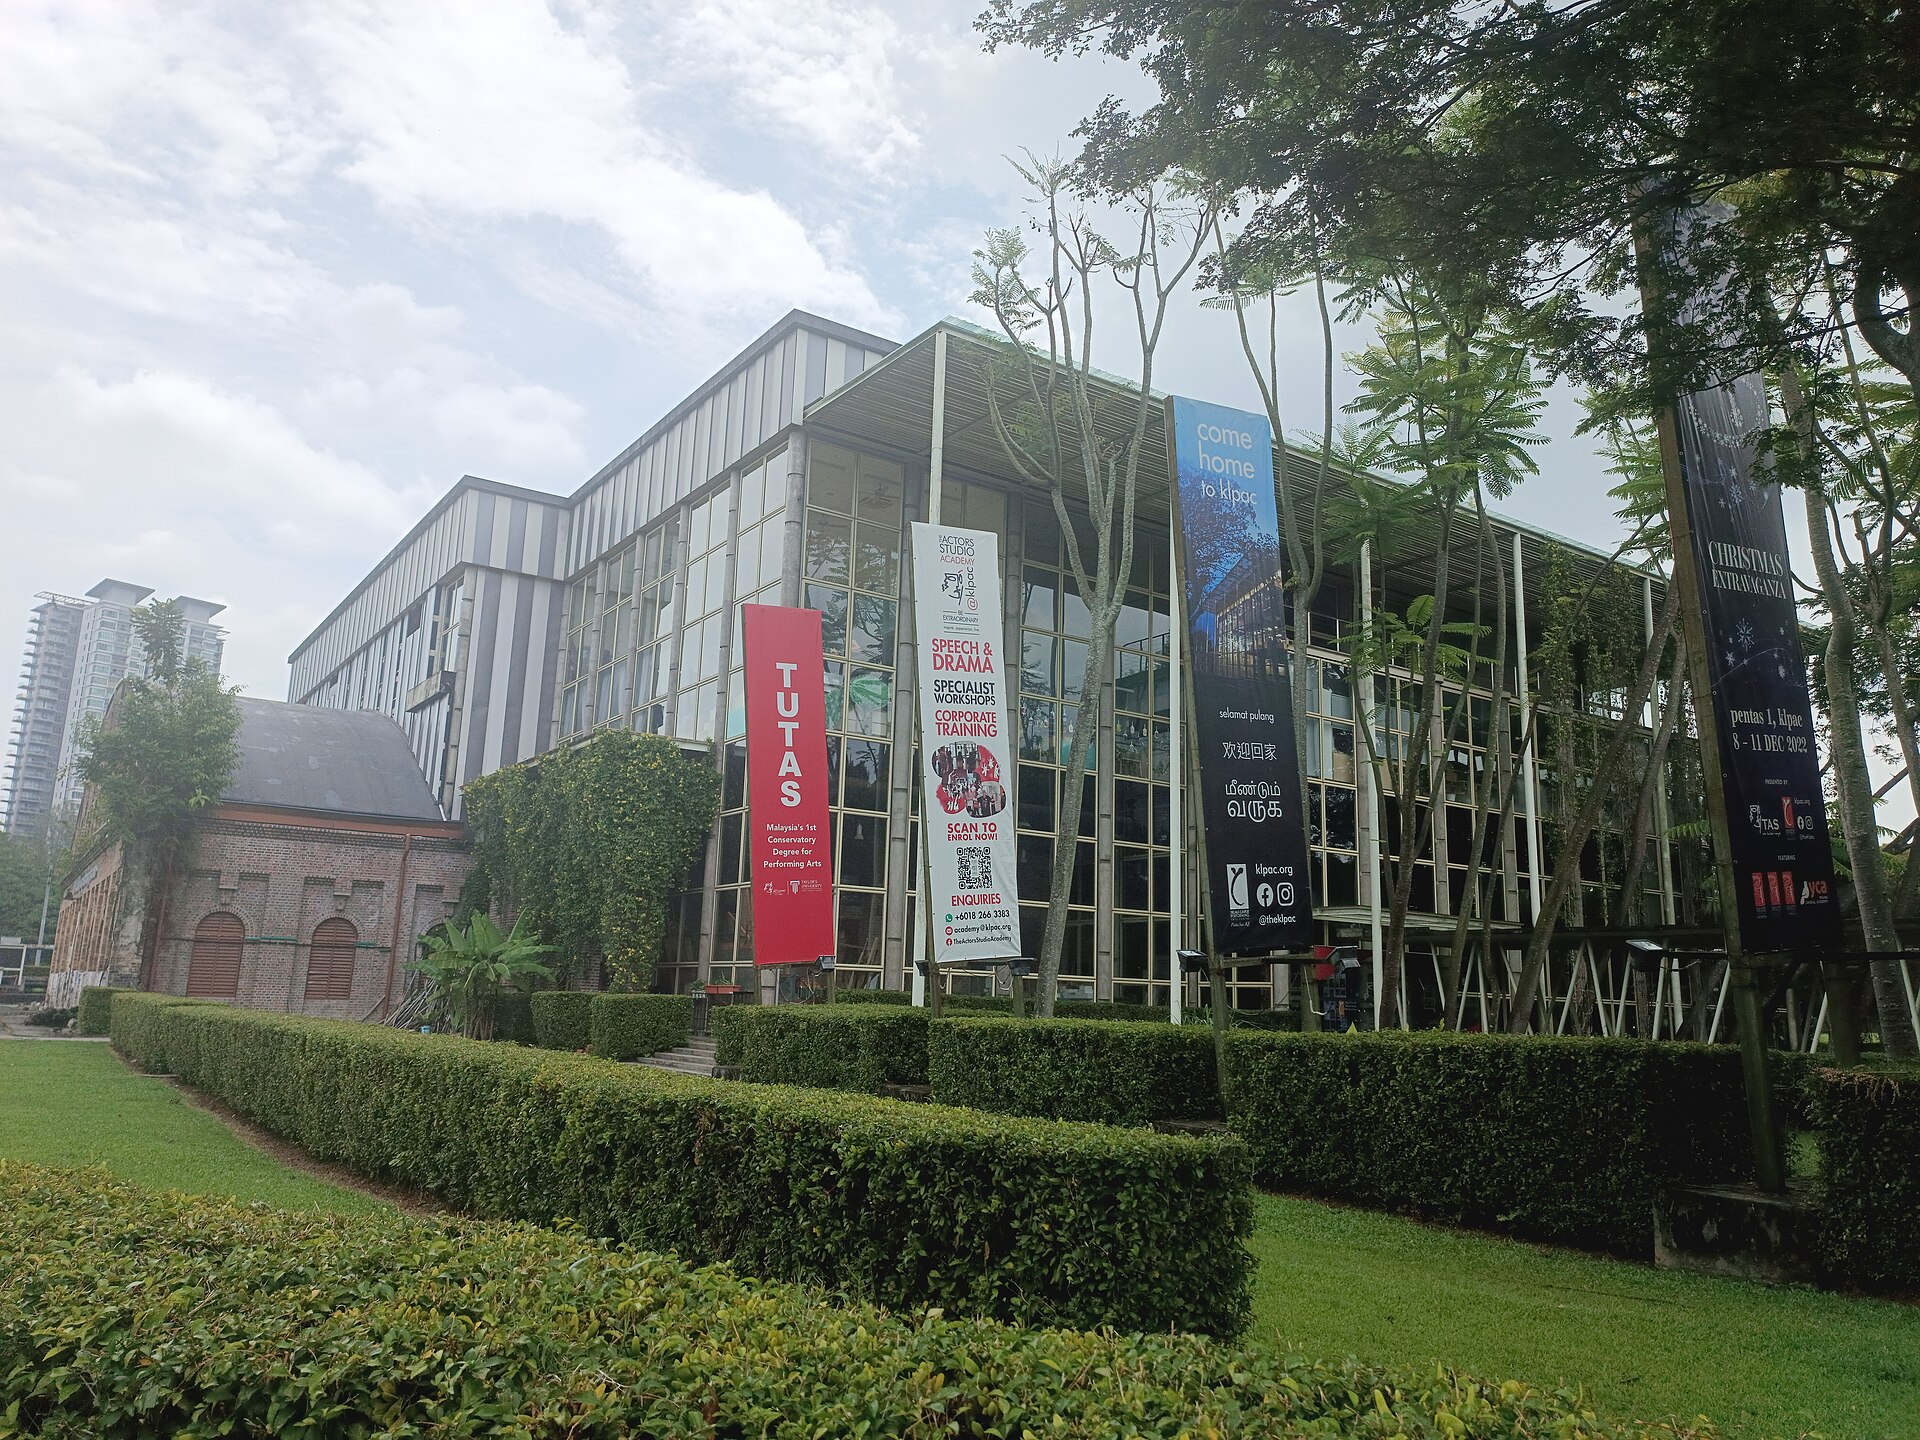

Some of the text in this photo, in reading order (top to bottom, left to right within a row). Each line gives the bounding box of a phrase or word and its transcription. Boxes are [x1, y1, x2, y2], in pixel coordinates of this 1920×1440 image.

[1197, 423, 1253, 450] come
[1198, 440, 1255, 479] home
[1201, 478, 1258, 507] to klpac
[941, 535, 975, 547] ACTORS
[939, 543, 975, 557] STUDIO
[939, 555, 975, 566] ACADEMY
[1708, 540, 1784, 577] CHRISTMAS
[965, 566, 979, 611] @klpac
[1712, 569, 1787, 600] EXTRAVAGANZA
[942, 614, 979, 624] EXTRAORDINARY
[931, 638, 993, 656] SPEECH &
[932, 653, 994, 674] DRAMA
[933, 679, 995, 695] SPECIALIST
[933, 692, 996, 706] WORKSHOPS
[935, 709, 997, 724] CORPORATE
[1219, 706, 1274, 724] selamat pulang
[1730, 707, 1803, 731] pentas 1, klpac
[775, 662, 803, 807] TUTAS
[935, 722, 998, 738] TRAINING
[1732, 732, 1740, 750] 8
[1750, 733, 1762, 751] 11
[1763, 734, 1785, 752] DEC
[1786, 736, 1808, 754] 2022
[1222, 741, 1277, 761] 欢迎回家
[1225, 779, 1281, 799] மீண்டும்
[1227, 800, 1283, 823] வருக
[766, 823, 817, 833] Malaysia's 1st
[947, 822, 997, 834] SCAN TO
[1762, 818, 1779, 830] TAS
[767, 835, 817, 845] Conservatory
[947, 832, 998, 841] ENROL NOW!
[772, 847, 812, 857] Degree for
[763, 860, 822, 869] Performing Arts
[1255, 863, 1293, 877] klpac.org
[1808, 879, 1828, 898] yca
[951, 893, 1001, 907] ENQUIRIES
[955, 909, 1010, 921] +6018 266 3383
[1258, 913, 1297, 926] @theklpac
[953, 923, 1012, 935] academy@klpac.org
[953, 935, 1012, 945] TheActorsStudioAcademy
